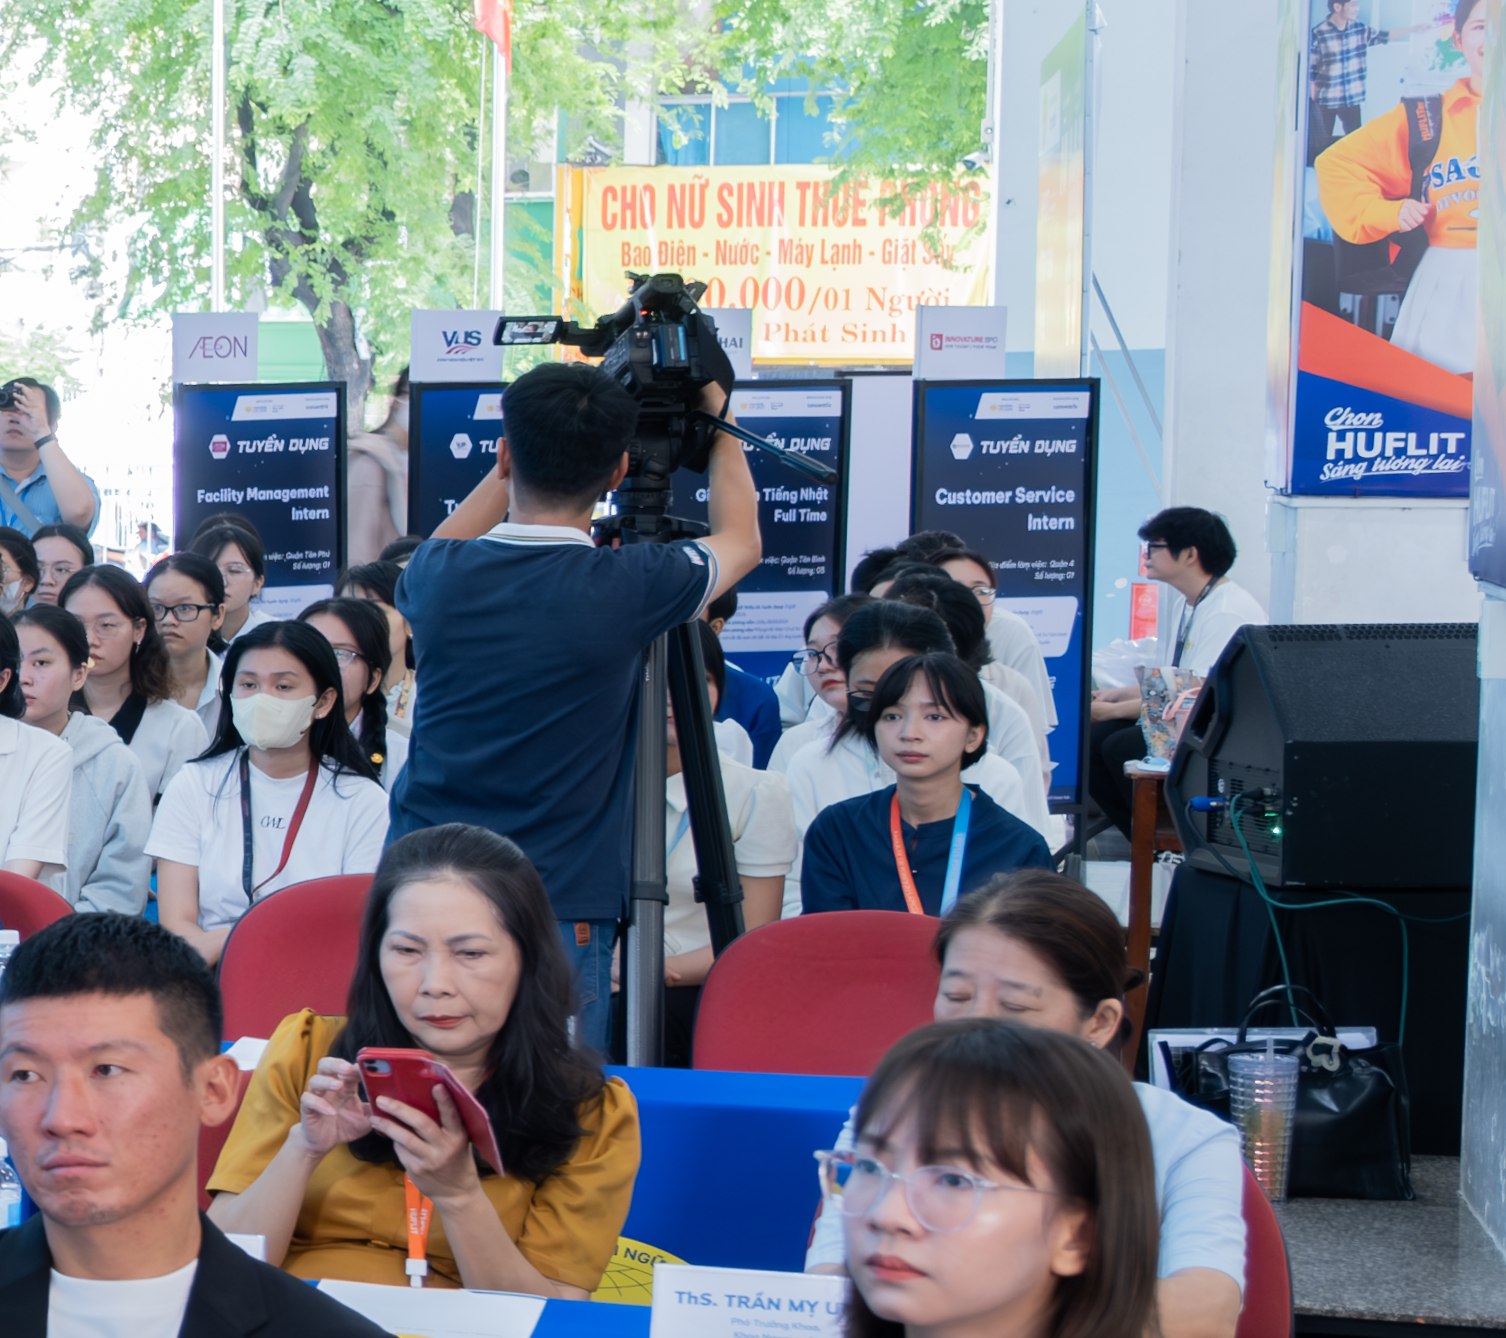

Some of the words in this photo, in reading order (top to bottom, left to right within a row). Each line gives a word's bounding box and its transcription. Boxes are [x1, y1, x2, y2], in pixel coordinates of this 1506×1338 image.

[601, 184, 655, 230] CHO
[666, 173, 708, 228] NỮ
[717, 182, 786, 228] SINH
[621, 241, 651, 266] Bao
[658, 239, 696, 266] Điện
[715, 238, 759, 266] Nước
[781, 239, 813, 268] Máy
[820, 239, 861, 271] Lạnh
[442, 330, 482, 348] VUS
[764, 320, 829, 343] Phát
[837, 320, 906, 344] Sinh
[237, 434, 284, 453] TUYỂN
[289, 438, 330, 454] DỤNG
[980, 435, 1030, 454] TUYỂN
[1034, 440, 1076, 456] DỤNG
[1326, 432, 1465, 460] HUFLIT
[1320, 461, 1368, 480] Sáng
[197, 488, 244, 504] Facility
[246, 485, 330, 502] Management
[763, 486, 798, 504] Tiếng
[800, 487, 828, 504] Nhật
[935, 488, 1012, 505] Customer
[1015, 486, 1075, 504] Service
[292, 507, 330, 520] Intern
[774, 509, 796, 522] Full
[799, 510, 827, 522] Time
[1027, 513, 1074, 531] Intern
[675, 1291, 718, 1307] ThS.
